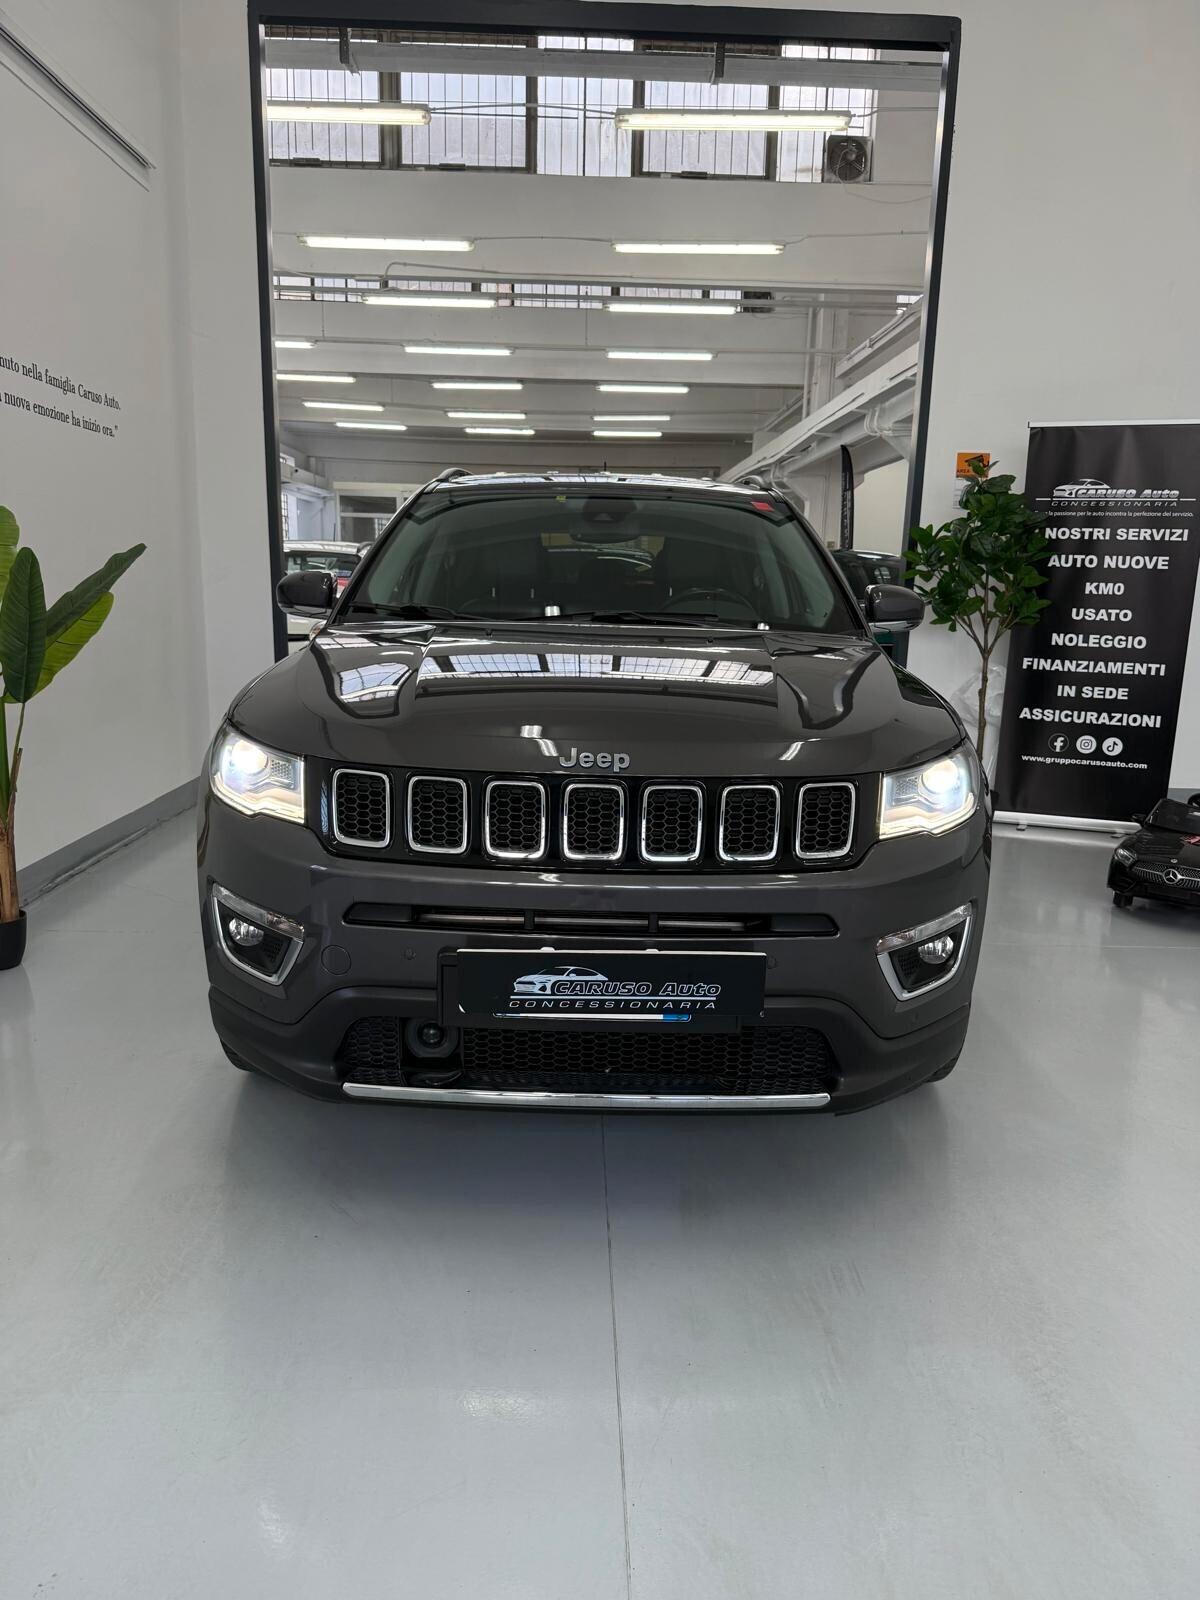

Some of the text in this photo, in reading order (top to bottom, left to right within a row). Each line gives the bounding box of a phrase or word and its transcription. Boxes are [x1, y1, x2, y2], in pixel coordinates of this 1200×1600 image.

[22, 363, 43, 382] nella
[45, 368, 76, 395] famiglia
[78, 384, 102, 405] Caruso
[104, 393, 121, 410] Auto.
[4, 392, 31, 411] nuova
[33, 403, 70, 423] emozione
[71, 410, 81, 427] ha
[82, 415, 101, 433] inizio
[1077, 488, 1180, 498] CARUSO Auto
[1044, 527, 1189, 542] NOSTRI SERVIZI
[1047, 554, 1170, 570] AUTO NUOVE
[1084, 582, 1125, 595] KM0
[1071, 608, 1133, 622] USATO
[1051, 632, 1147, 649] NOLEGGIO
[1022, 657, 1166, 677] FINANZIAMENTI
[1056, 684, 1129, 700] IN SEDE
[1018, 707, 1162, 729] ASSICURAZIONI
[559, 747, 630, 773] Jeep
[1021, 754, 1148, 769] www.gruppocarusoauto.com
[554, 981, 722, 996] CARUSO Auto
[509, 1000, 717, 1010] CONCESSIONARIA
